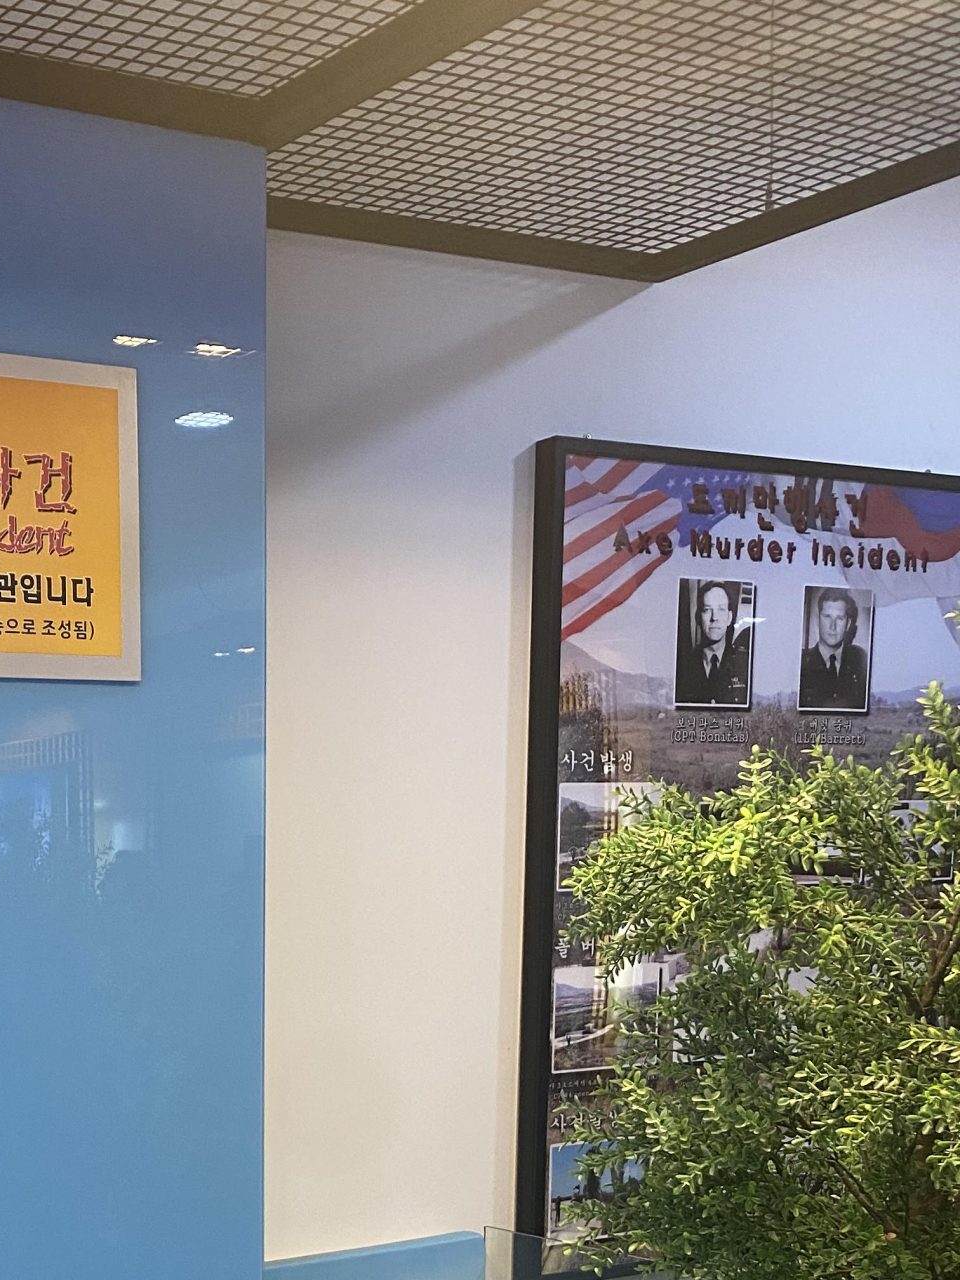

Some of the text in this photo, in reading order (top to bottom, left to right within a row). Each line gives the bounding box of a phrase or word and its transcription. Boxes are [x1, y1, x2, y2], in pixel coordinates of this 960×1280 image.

[613, 521, 929, 573] Axe Murder Incident
[41, 619, 95, 641] 조성됨)
[670, 730, 749, 744] (CPT Bonifas)
